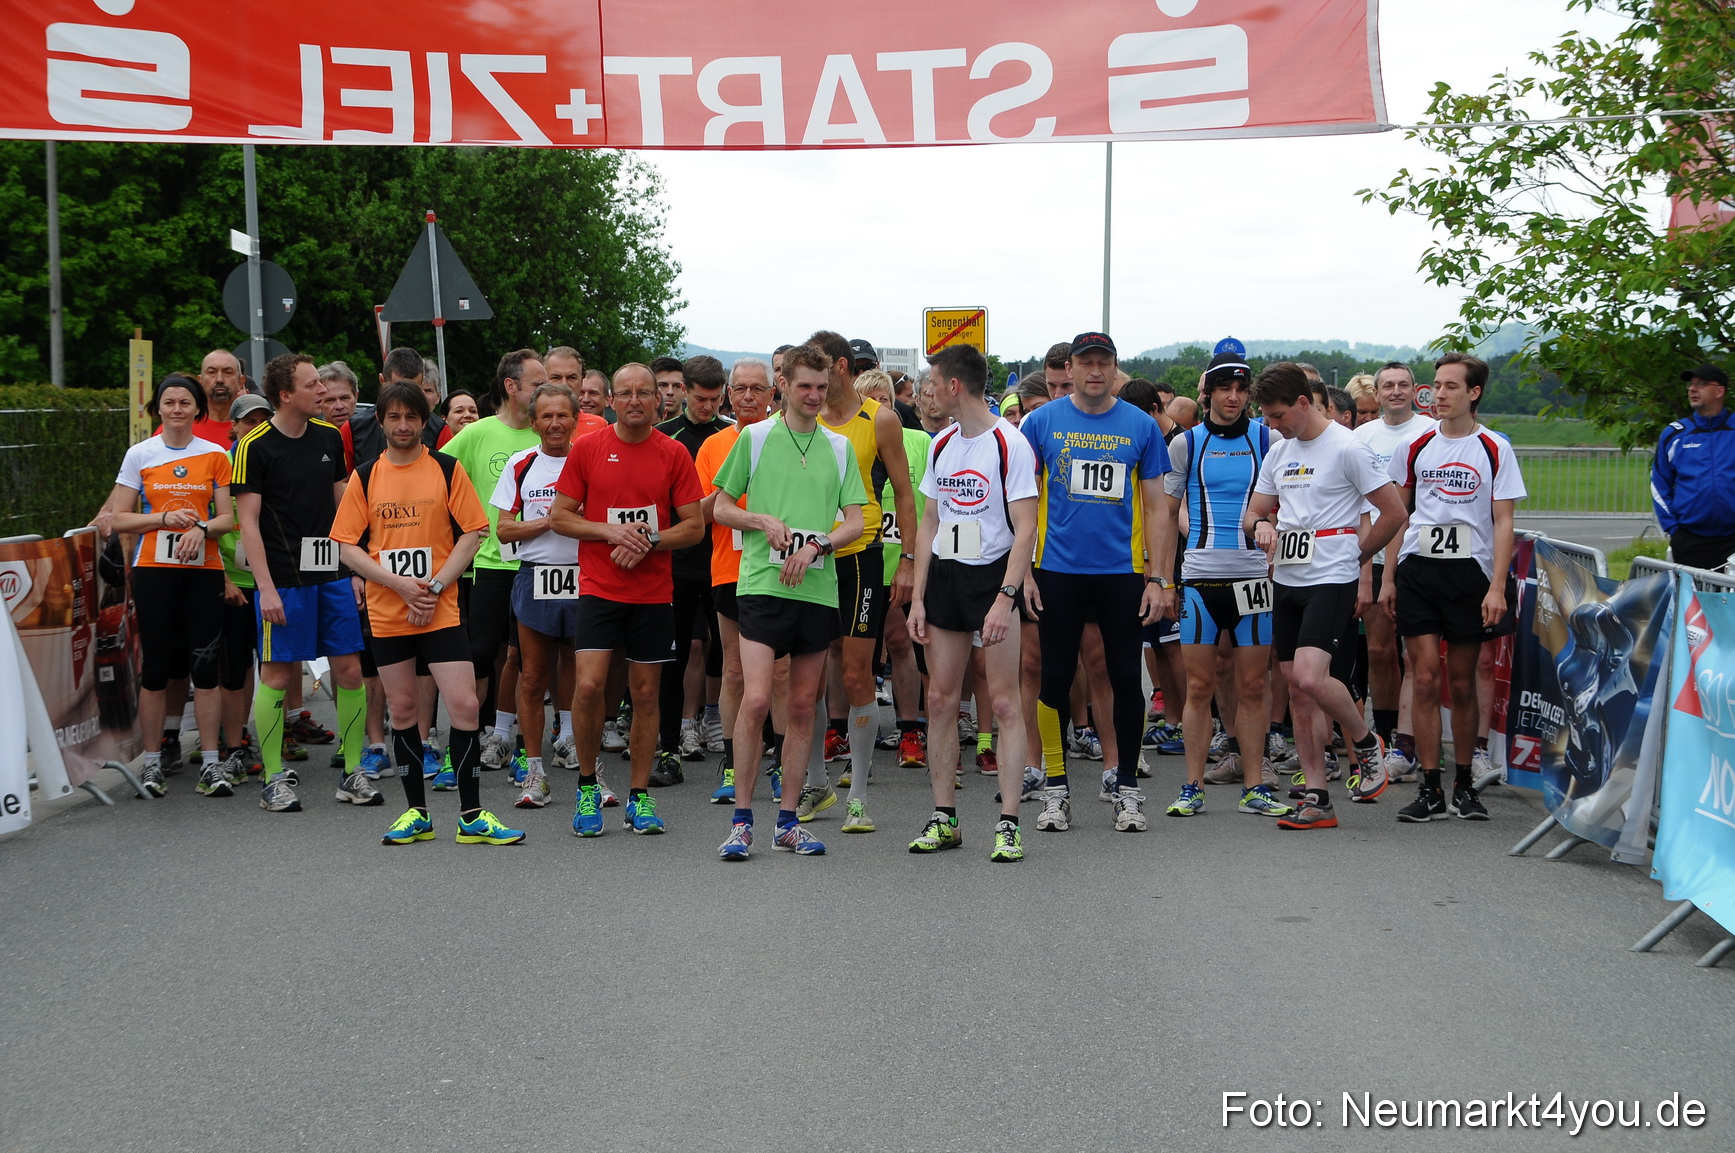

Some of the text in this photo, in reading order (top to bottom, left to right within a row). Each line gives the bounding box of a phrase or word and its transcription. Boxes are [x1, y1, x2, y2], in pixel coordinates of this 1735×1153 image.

[931, 316, 980, 330] Sengenthal
[1419, 392, 1430, 403] 60
[1064, 439, 1118, 450] STADTLAUF
[1067, 432, 1131, 446] NEUMARKTER
[153, 482, 207, 490] SportScheck
[936, 477, 977, 487] GERHART
[1082, 463, 1113, 492] 119
[1421, 470, 1470, 480] GERHART
[381, 506, 420, 519] OEXL
[952, 524, 959, 553] 1
[1281, 531, 1310, 560] 106
[1431, 527, 1459, 554] 24
[313, 539, 331, 565] 111
[388, 550, 427, 578] 120
[541, 568, 576, 595] 104
[860, 588, 872, 623] SKINS
[1242, 581, 1270, 610] 141
[1512, 738, 1535, 765] 7
